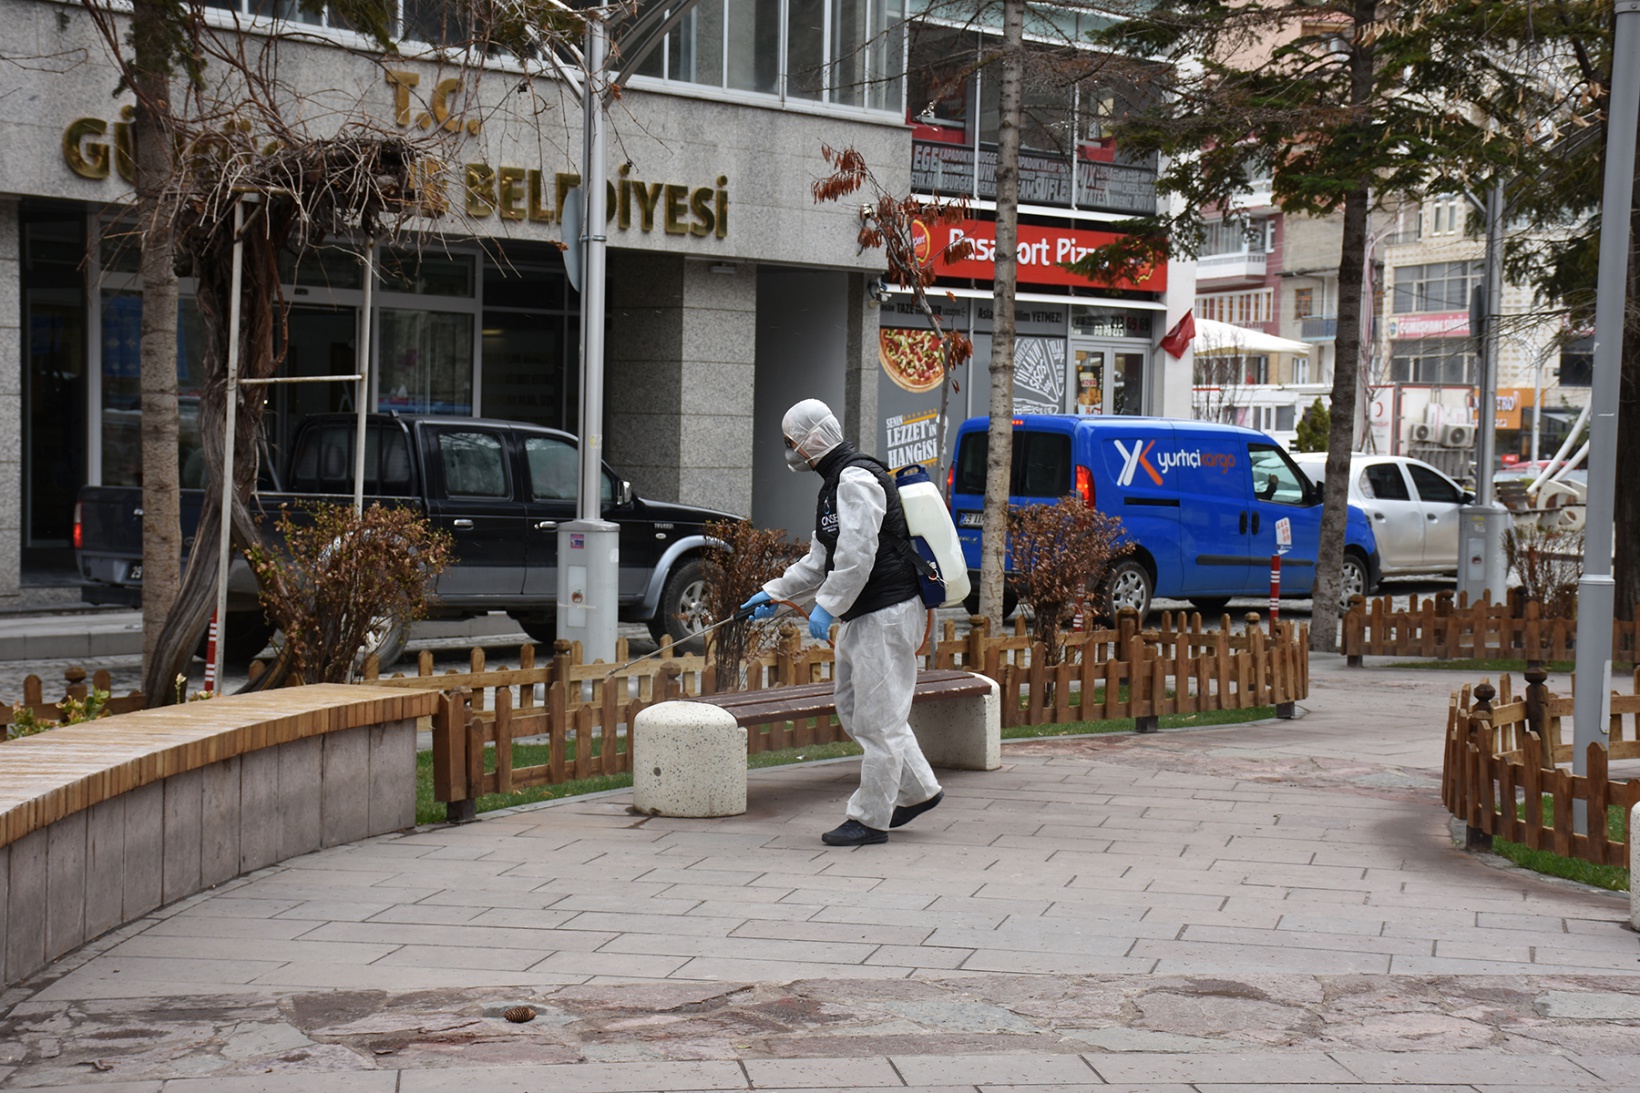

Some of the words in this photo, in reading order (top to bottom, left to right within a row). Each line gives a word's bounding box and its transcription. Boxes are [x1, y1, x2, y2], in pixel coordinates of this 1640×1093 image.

[386, 70, 481, 135] T.C.
[914, 145, 939, 172] EGE
[1032, 311, 1062, 323] YETMEZ!
